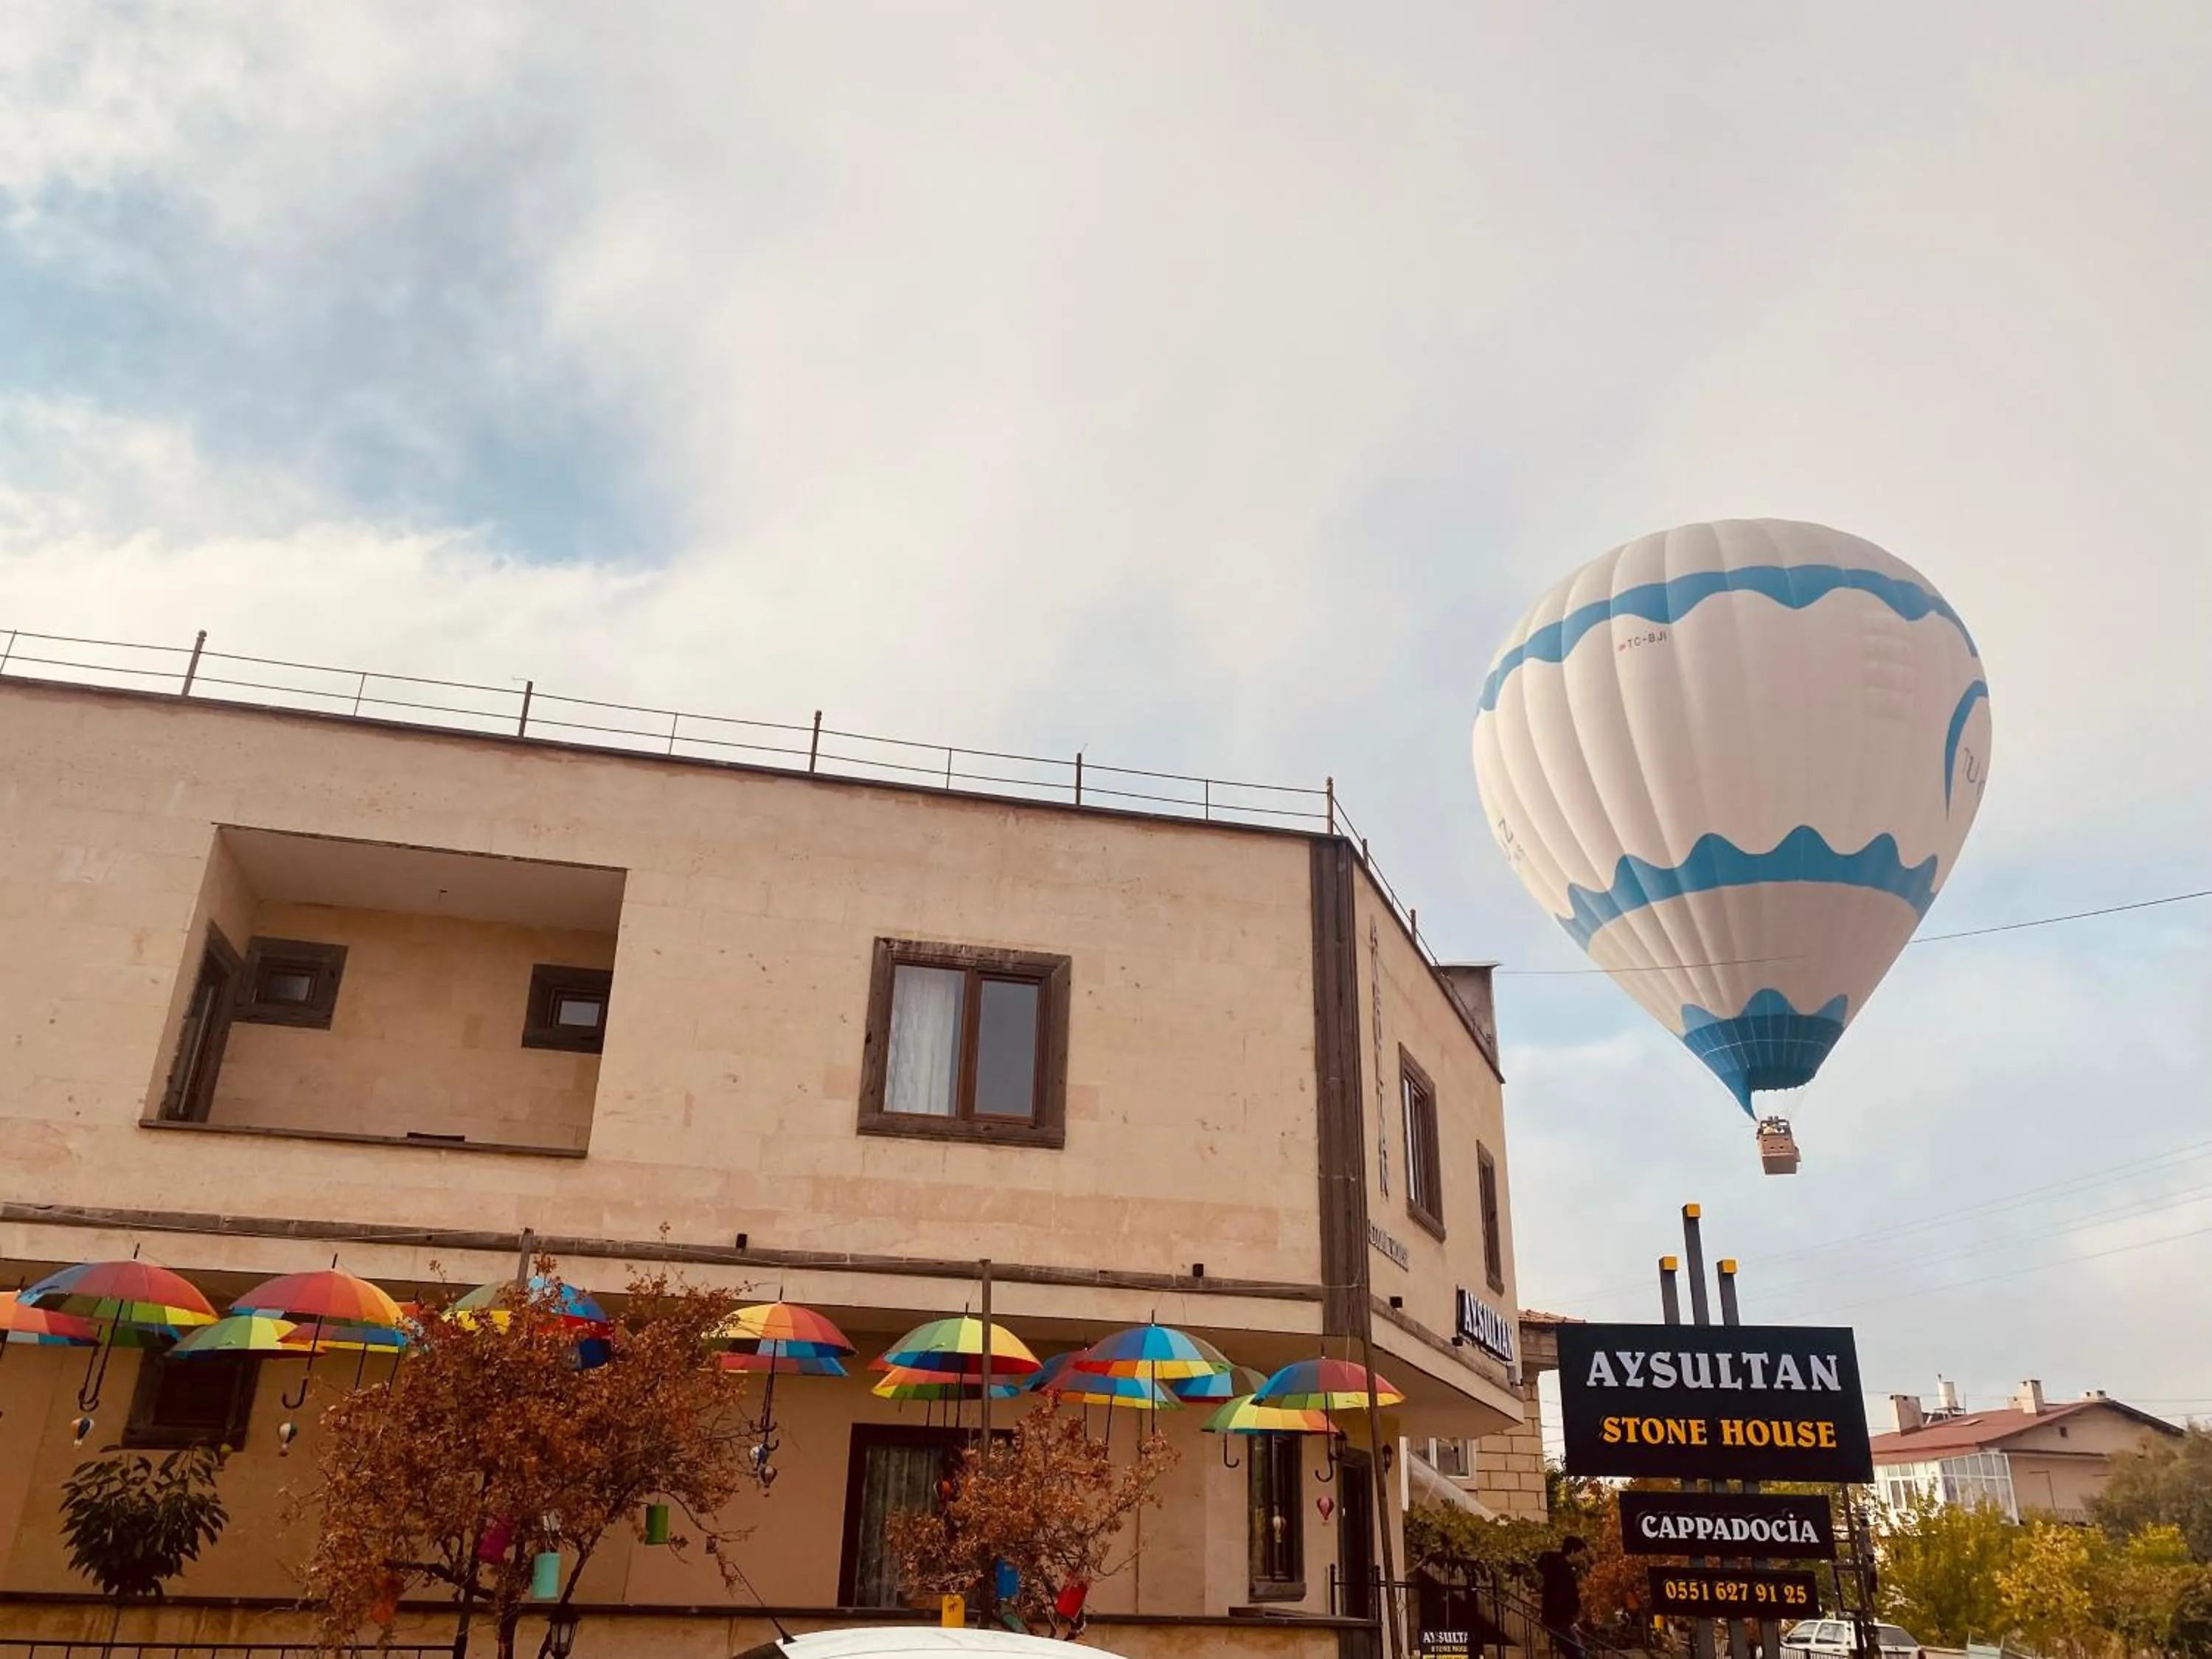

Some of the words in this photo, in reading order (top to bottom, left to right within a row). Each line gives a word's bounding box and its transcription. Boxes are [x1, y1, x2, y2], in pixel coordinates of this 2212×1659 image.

[1464, 1290, 1513, 1359] AYSULTAN
[1586, 1351, 1842, 1391] AYSULTAN
[1601, 1416, 1708, 1446] STONE
[1720, 1419, 1838, 1448] HOUSE
[1665, 1581, 1711, 1600] 0551
[1715, 1582, 1748, 1601] 627
[1756, 1583, 1777, 1603] 91
[1784, 1584, 1808, 1604] 25
